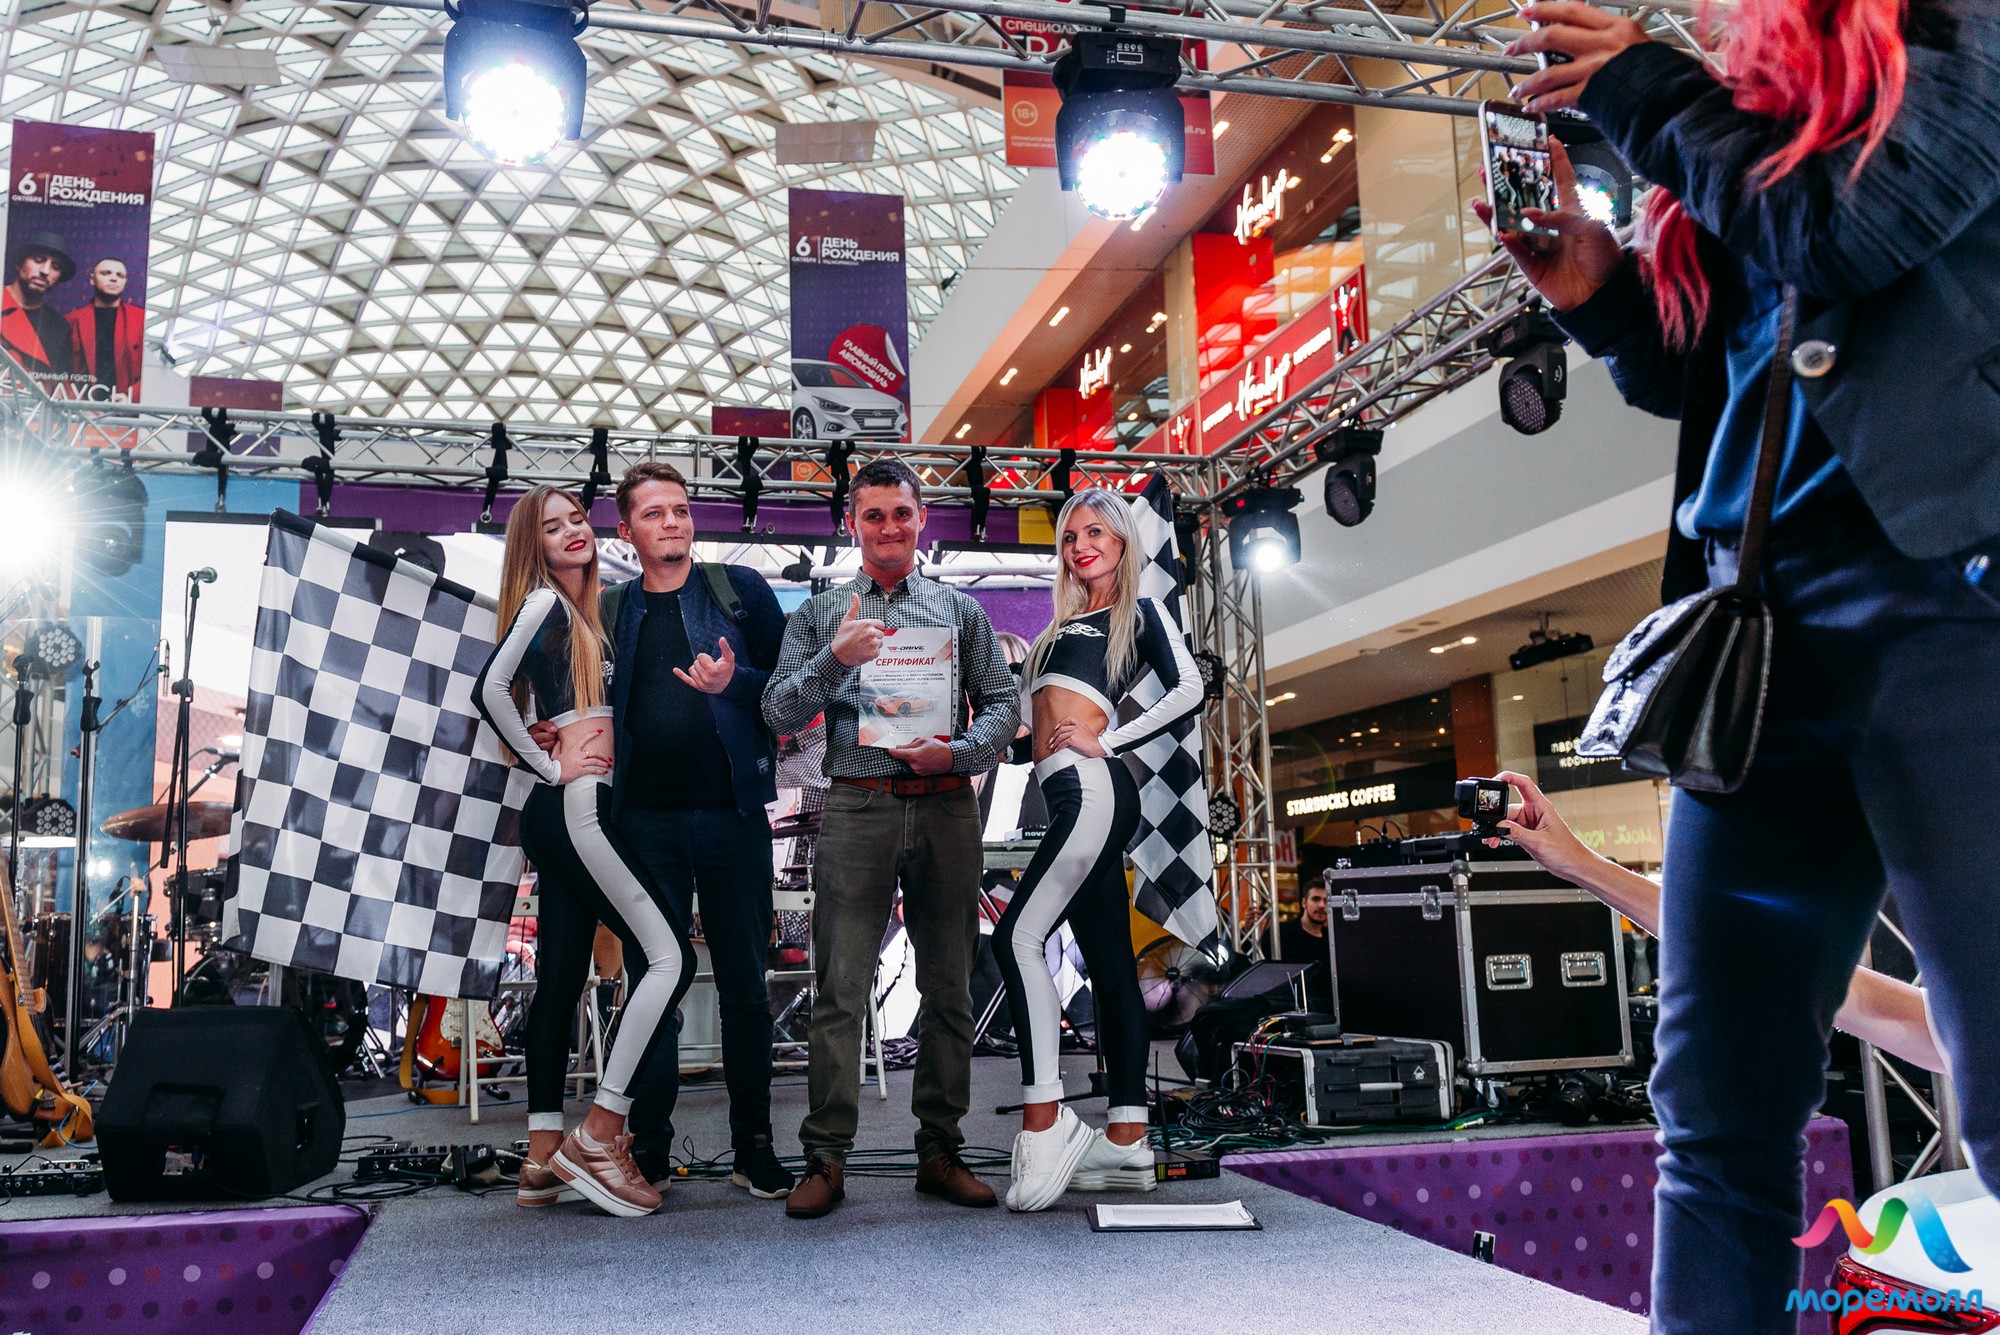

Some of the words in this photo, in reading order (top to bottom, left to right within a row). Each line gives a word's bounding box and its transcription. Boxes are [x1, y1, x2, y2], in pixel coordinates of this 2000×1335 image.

[18, 172, 37, 195] 6
[50, 174, 95, 189] ДЕНЬ
[49, 186, 145, 206] РОЖДЕНИЯ
[795, 235, 811, 256] 6
[821, 237, 858, 249] ДЕНЬ
[821, 248, 899, 262] РОЖДЕНИЯ
[839, 349, 888, 388] АВТОМОБИЛЬ
[843, 339, 879, 368] ГЛАВНЫЙ
[876, 363, 896, 381] ПРИЗ
[875, 657, 936, 667] СЕРТИФИКАТ
[1286, 791, 1349, 817] STARBUCKS
[1350, 783, 1396, 807] COFFEE
